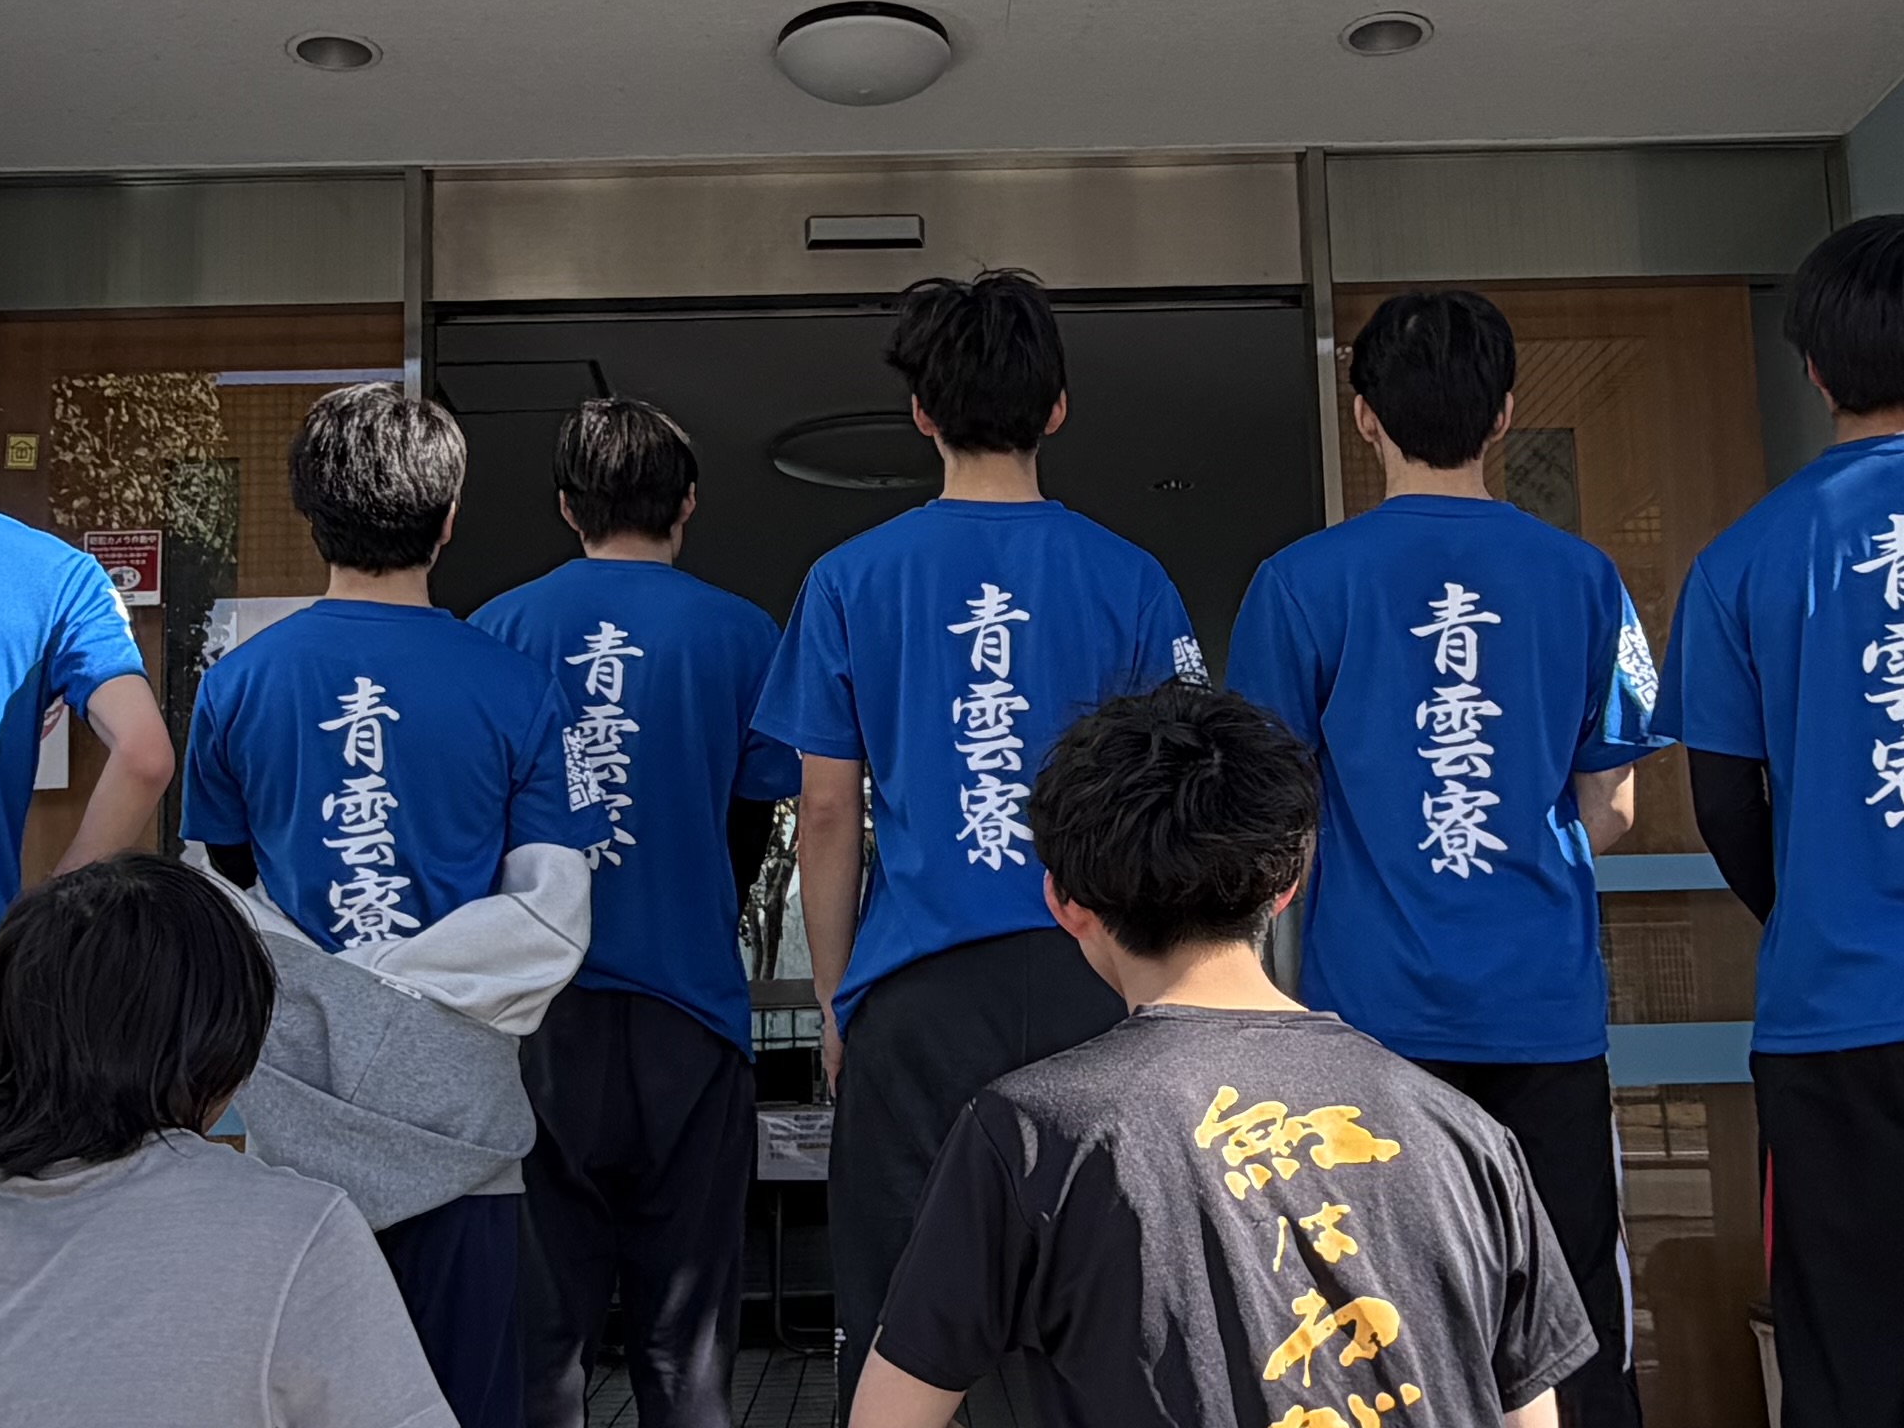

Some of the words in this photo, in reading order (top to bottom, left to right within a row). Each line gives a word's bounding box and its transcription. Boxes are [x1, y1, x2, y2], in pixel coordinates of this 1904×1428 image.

[318, 676, 421, 948] 青雲寮
[947, 582, 1034, 871] 青雲寮
[1409, 582, 1508, 879] 青雲寮
